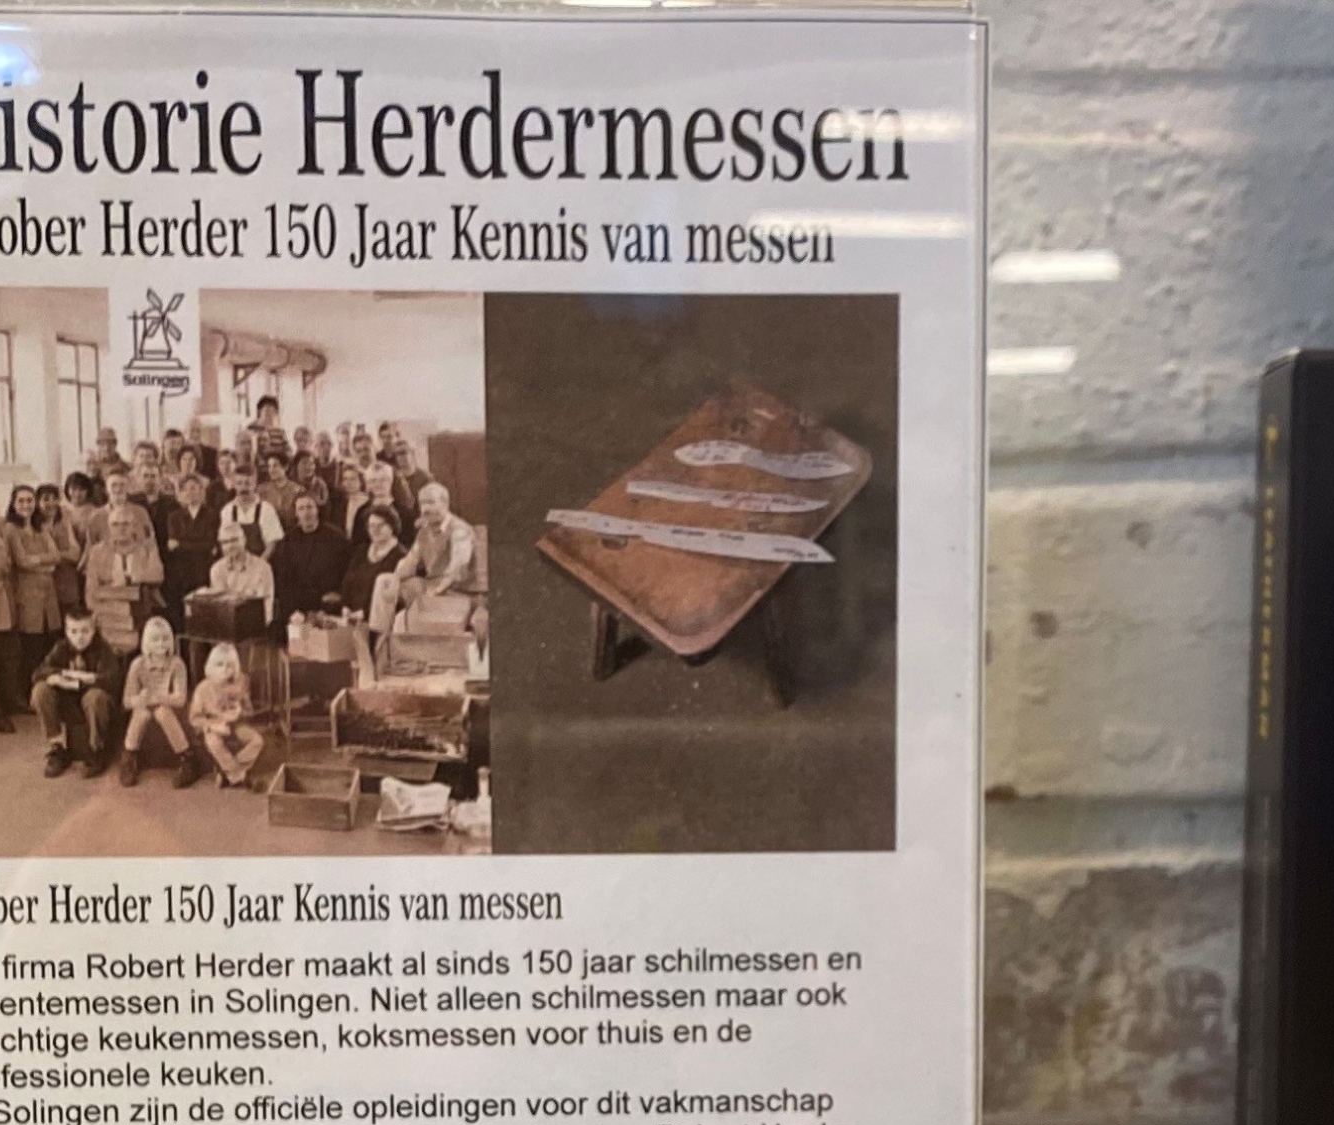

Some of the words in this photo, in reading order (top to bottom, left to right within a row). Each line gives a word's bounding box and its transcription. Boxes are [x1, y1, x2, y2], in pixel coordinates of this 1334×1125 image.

[295, 69, 909, 182] Herdermessen
[100, 199, 248, 258] Herder
[265, 203, 336, 259] 150
[350, 203, 436, 268] Jaar
[451, 205, 588, 262] Kennis
[602, 224, 671, 262] van
[686, 224, 834, 263] messen
[49, 883, 151, 924] Herder
[164, 884, 214, 923] 150
[224, 884, 284, 928] Jaar
[295, 883, 390, 922] Kennis
[400, 894, 449, 920] van
[460, 893, 562, 920] messen
[2, 954, 74, 980] firma
[87, 953, 185, 979] Robert
[196, 952, 295, 978] Herder
[305, 951, 392, 977] maakt
[402, 951, 425, 976] al
[437, 950, 510, 976] sinds
[523, 949, 572, 974] 150
[581, 949, 635, 980] jaar
[645, 948, 817, 973] schilmessen
[828, 952, 861, 970] en
[191, 989, 213, 1014] in
[226, 988, 358, 1019] Solingen.
[371, 986, 427, 1012] Niet
[437, 986, 520, 1011] alleen
[532, 985, 705, 1010] schilmessen
[716, 988, 787, 1007] maar
[796, 982, 846, 1006] ook
[99, 1026, 326, 1053] keukenmessen,
[338, 1023, 515, 1048] koksmessen
[526, 1026, 588, 1045] voor
[597, 1019, 663, 1044] thuis
[673, 1025, 707, 1043] en
[717, 1018, 751, 1042] de
[161, 1061, 272, 1086] keuken.
[189, 1097, 224, 1122] de
[235, 1095, 343, 1121] officiële
[353, 1093, 516, 1125] opleidingen
[526, 1097, 588, 1116] voor
[597, 1090, 630, 1115] dit
[640, 1088, 833, 1117] vakmanschap
